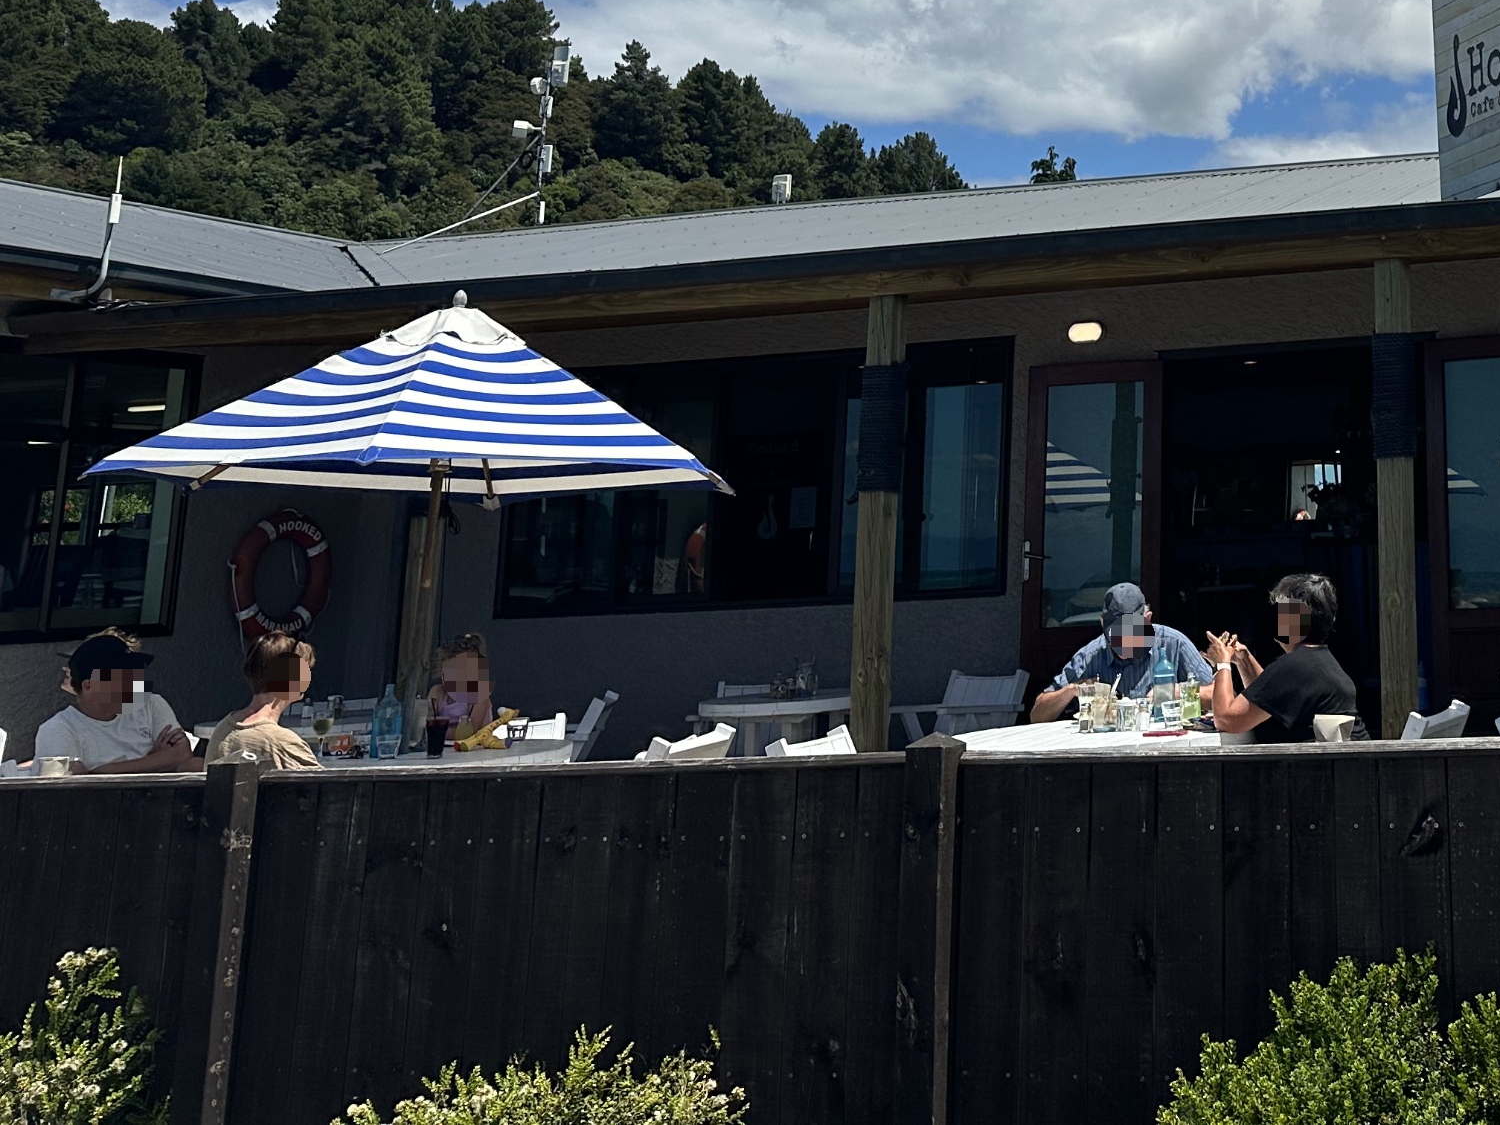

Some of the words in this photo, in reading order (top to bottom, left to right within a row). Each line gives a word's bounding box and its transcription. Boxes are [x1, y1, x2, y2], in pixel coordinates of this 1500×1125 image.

[1470, 96, 1495, 118] Cafe
[279, 520, 322, 542] HOOKED
[255, 611, 303, 633] MARAHAU
